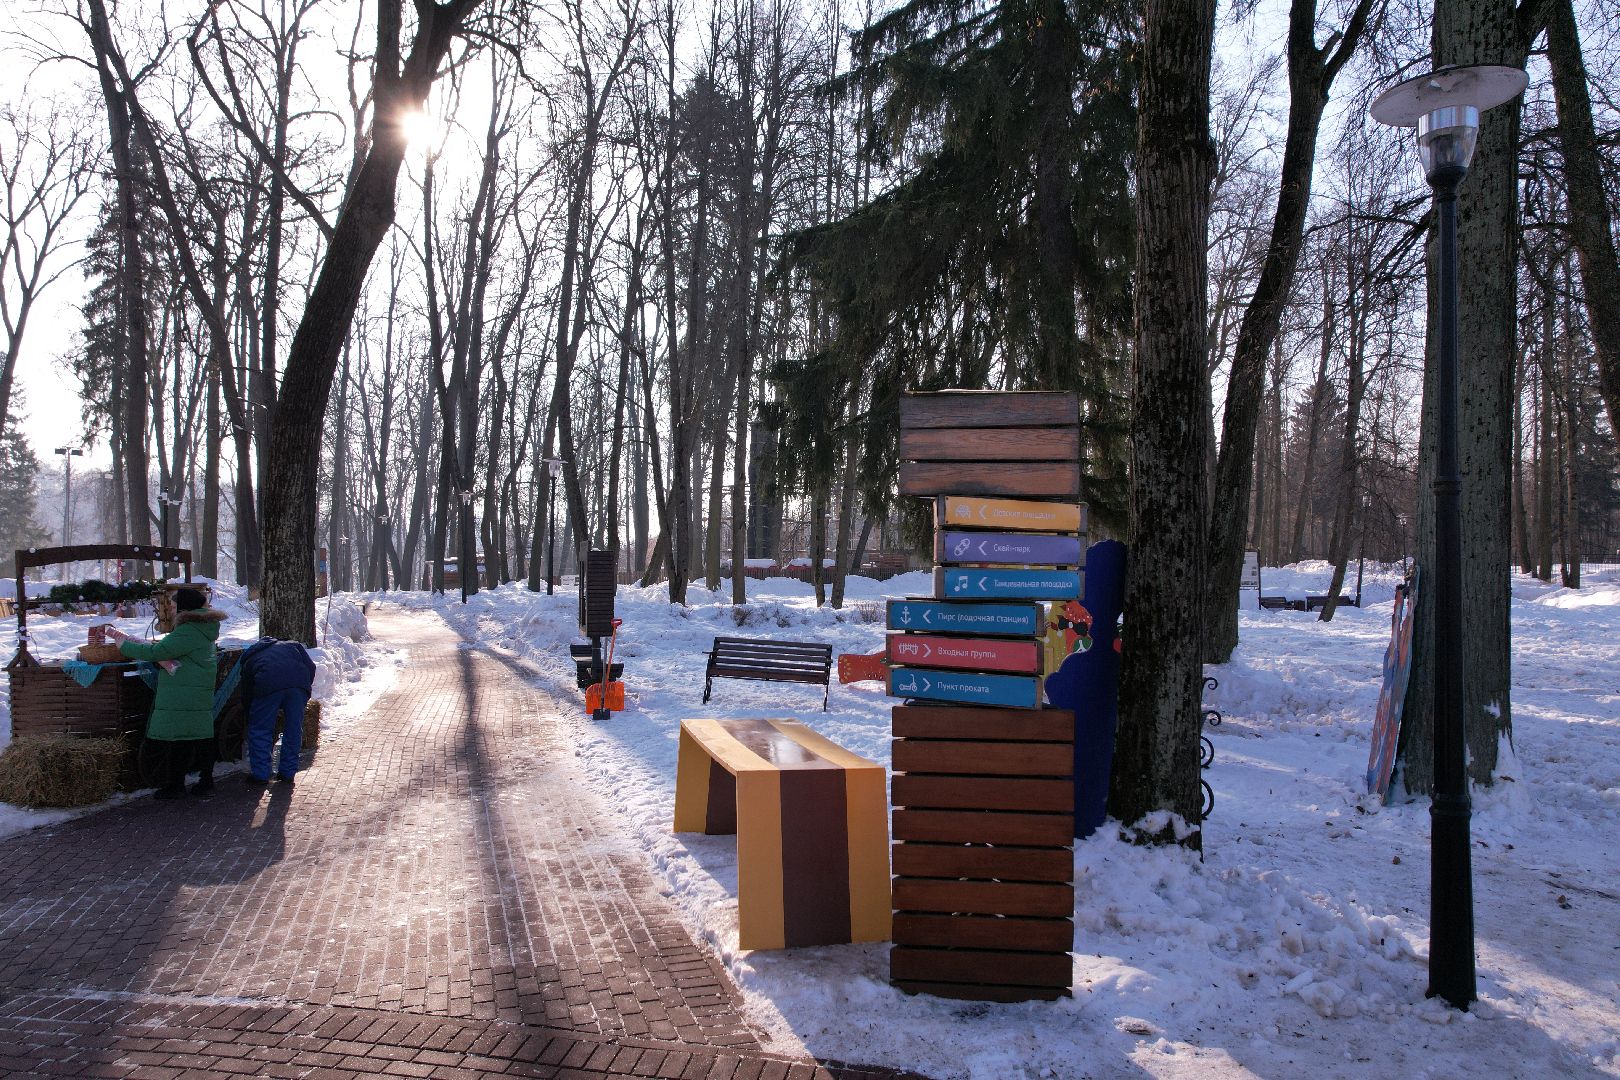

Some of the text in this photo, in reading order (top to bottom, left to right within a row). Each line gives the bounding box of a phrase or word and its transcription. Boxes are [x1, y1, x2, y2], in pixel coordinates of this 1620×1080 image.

[937, 612, 1029, 625] Пирс (лодочная станция)
[937, 646, 997, 659] Входная группа
[937, 681, 990, 693] Пункт проката
